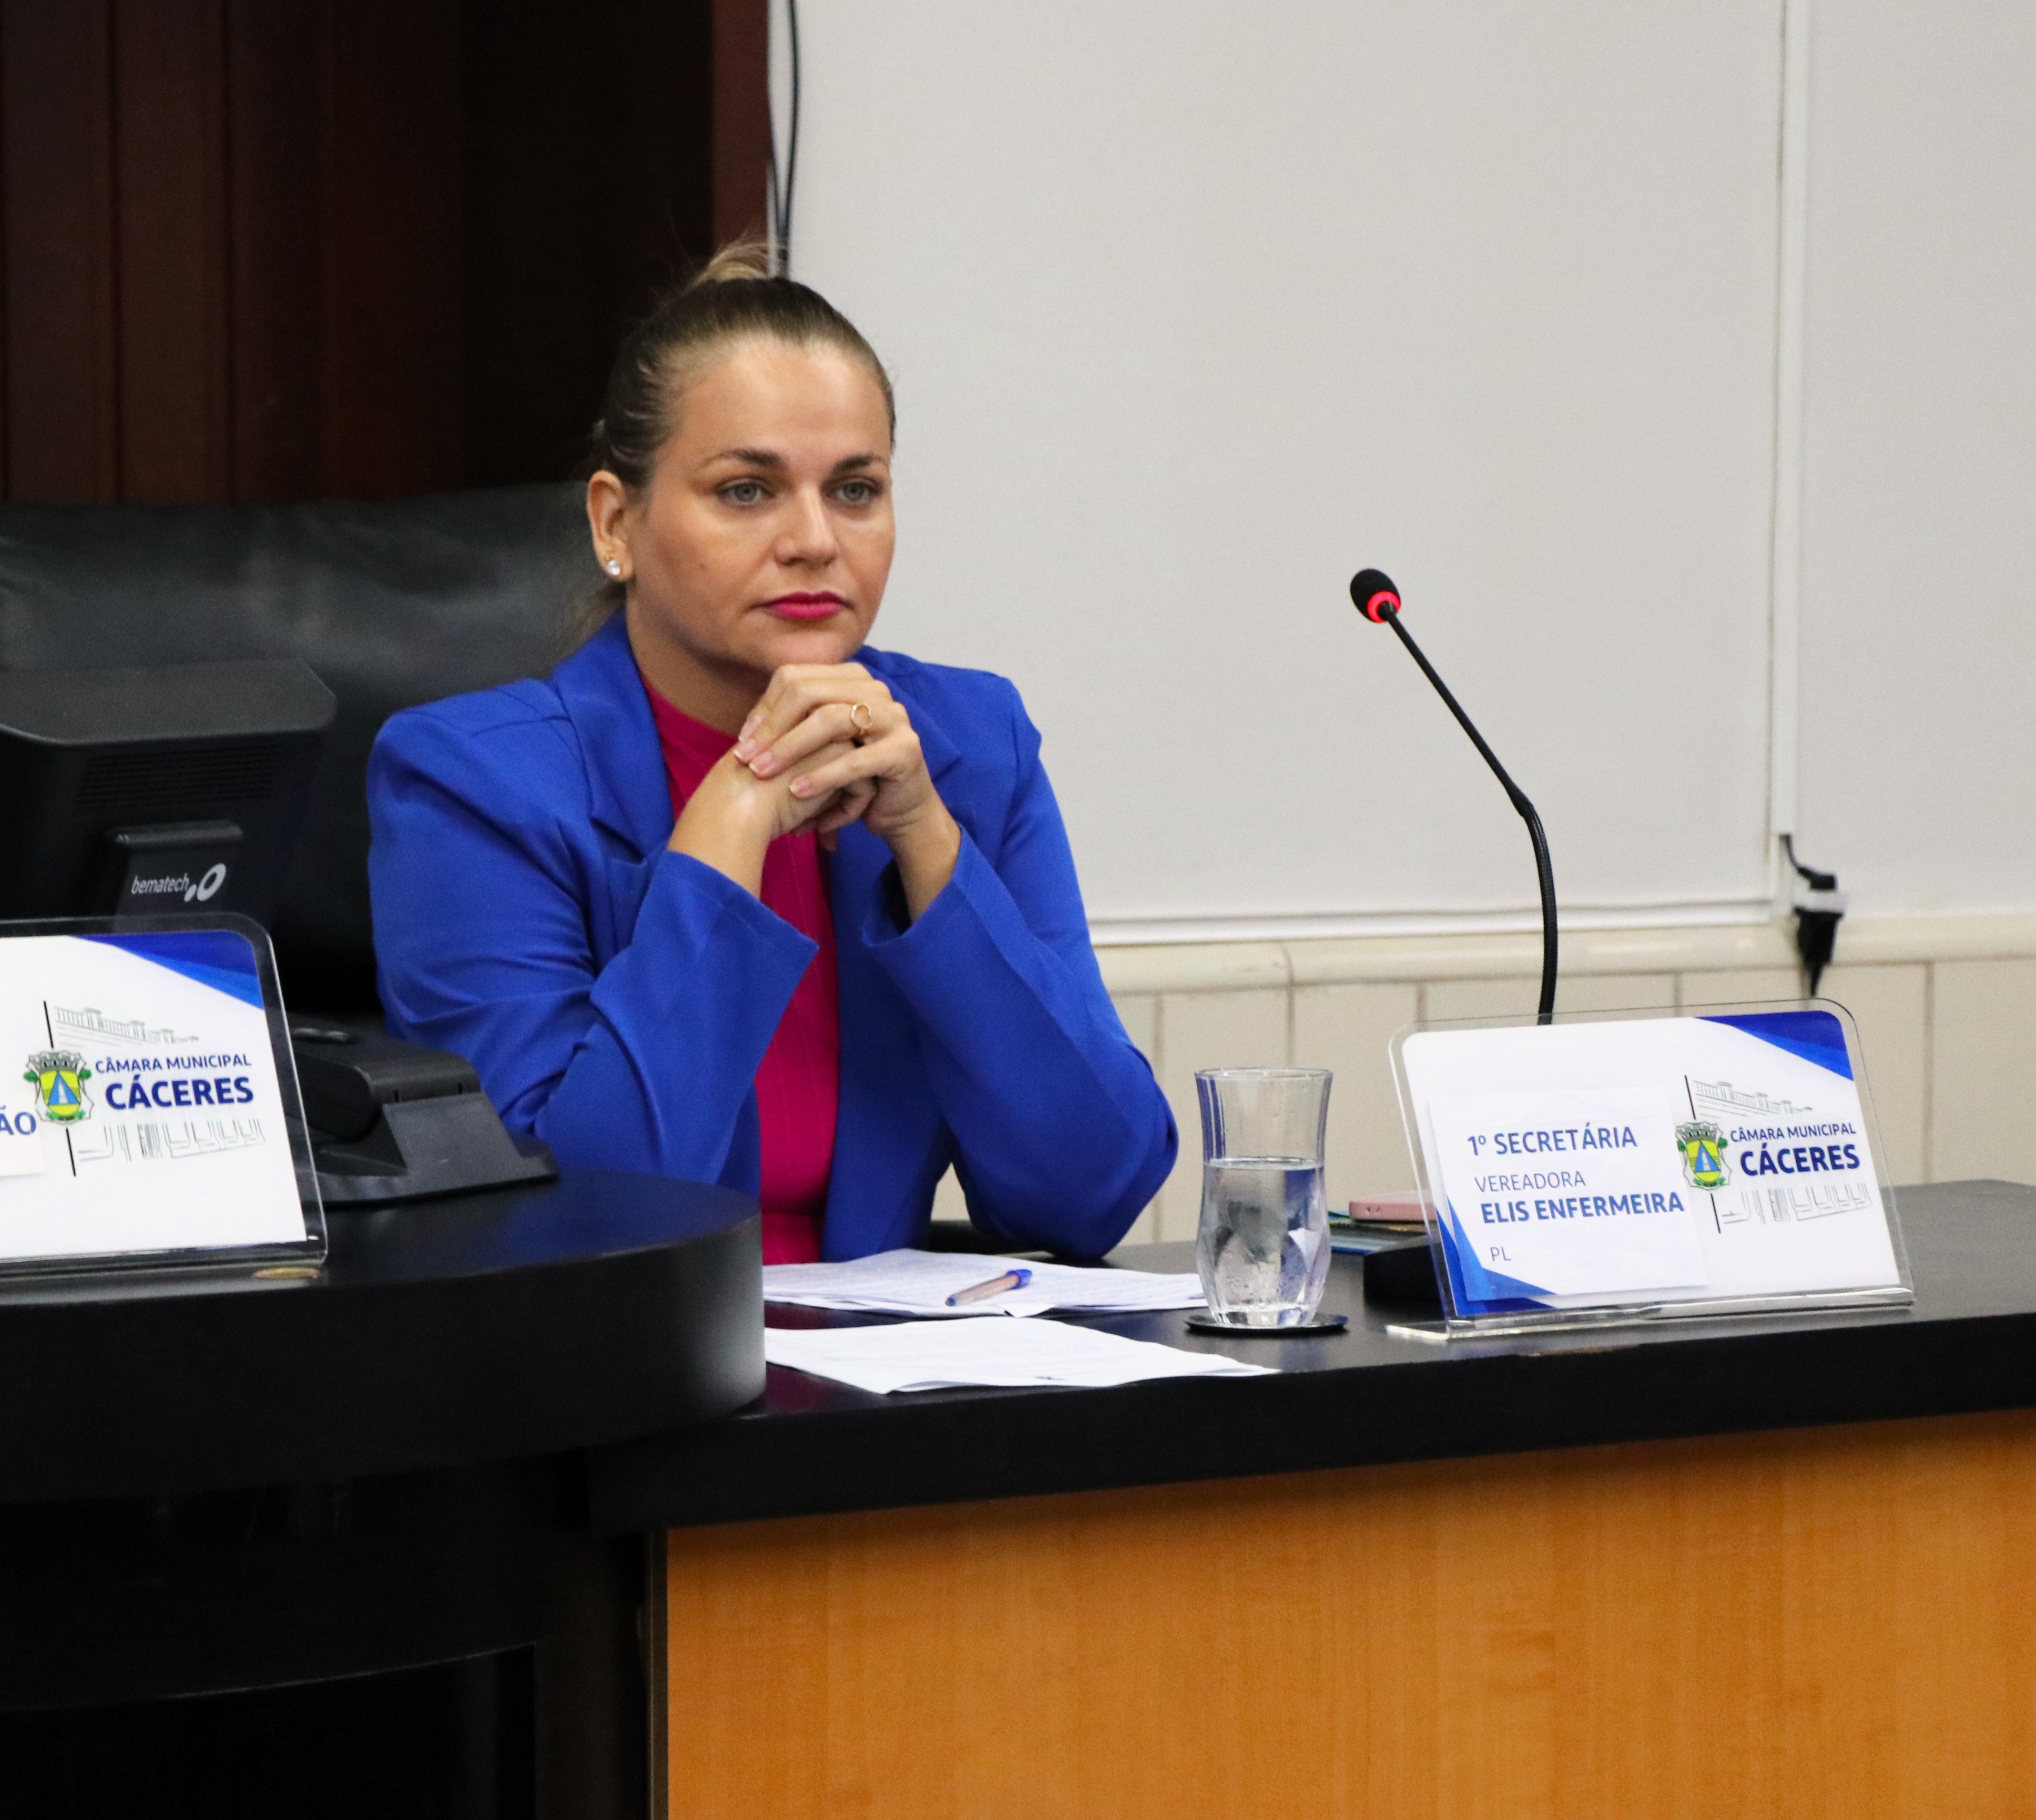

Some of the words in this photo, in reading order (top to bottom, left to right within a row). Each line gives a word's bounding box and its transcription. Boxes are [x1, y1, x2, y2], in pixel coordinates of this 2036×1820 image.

[131, 873, 190, 894] bematech
[95, 1057, 162, 1073] CÂMARA
[166, 1054, 252, 1070] MUNICIPAL
[105, 1073, 254, 1110] CÁCERES
[1494, 1122, 1638, 1154] SECRETÁRIA
[1730, 1127, 1785, 1142] CÂMARA
[1787, 1123, 1856, 1139] MUNICIPAL
[1740, 1142, 1860, 1177] CÁCERES
[1474, 1171, 1586, 1192] VEREADORA
[1480, 1201, 1530, 1224] ELIS
[1534, 1192, 1685, 1220] ENFERMEIRA
[1490, 1246, 1512, 1262] PL
